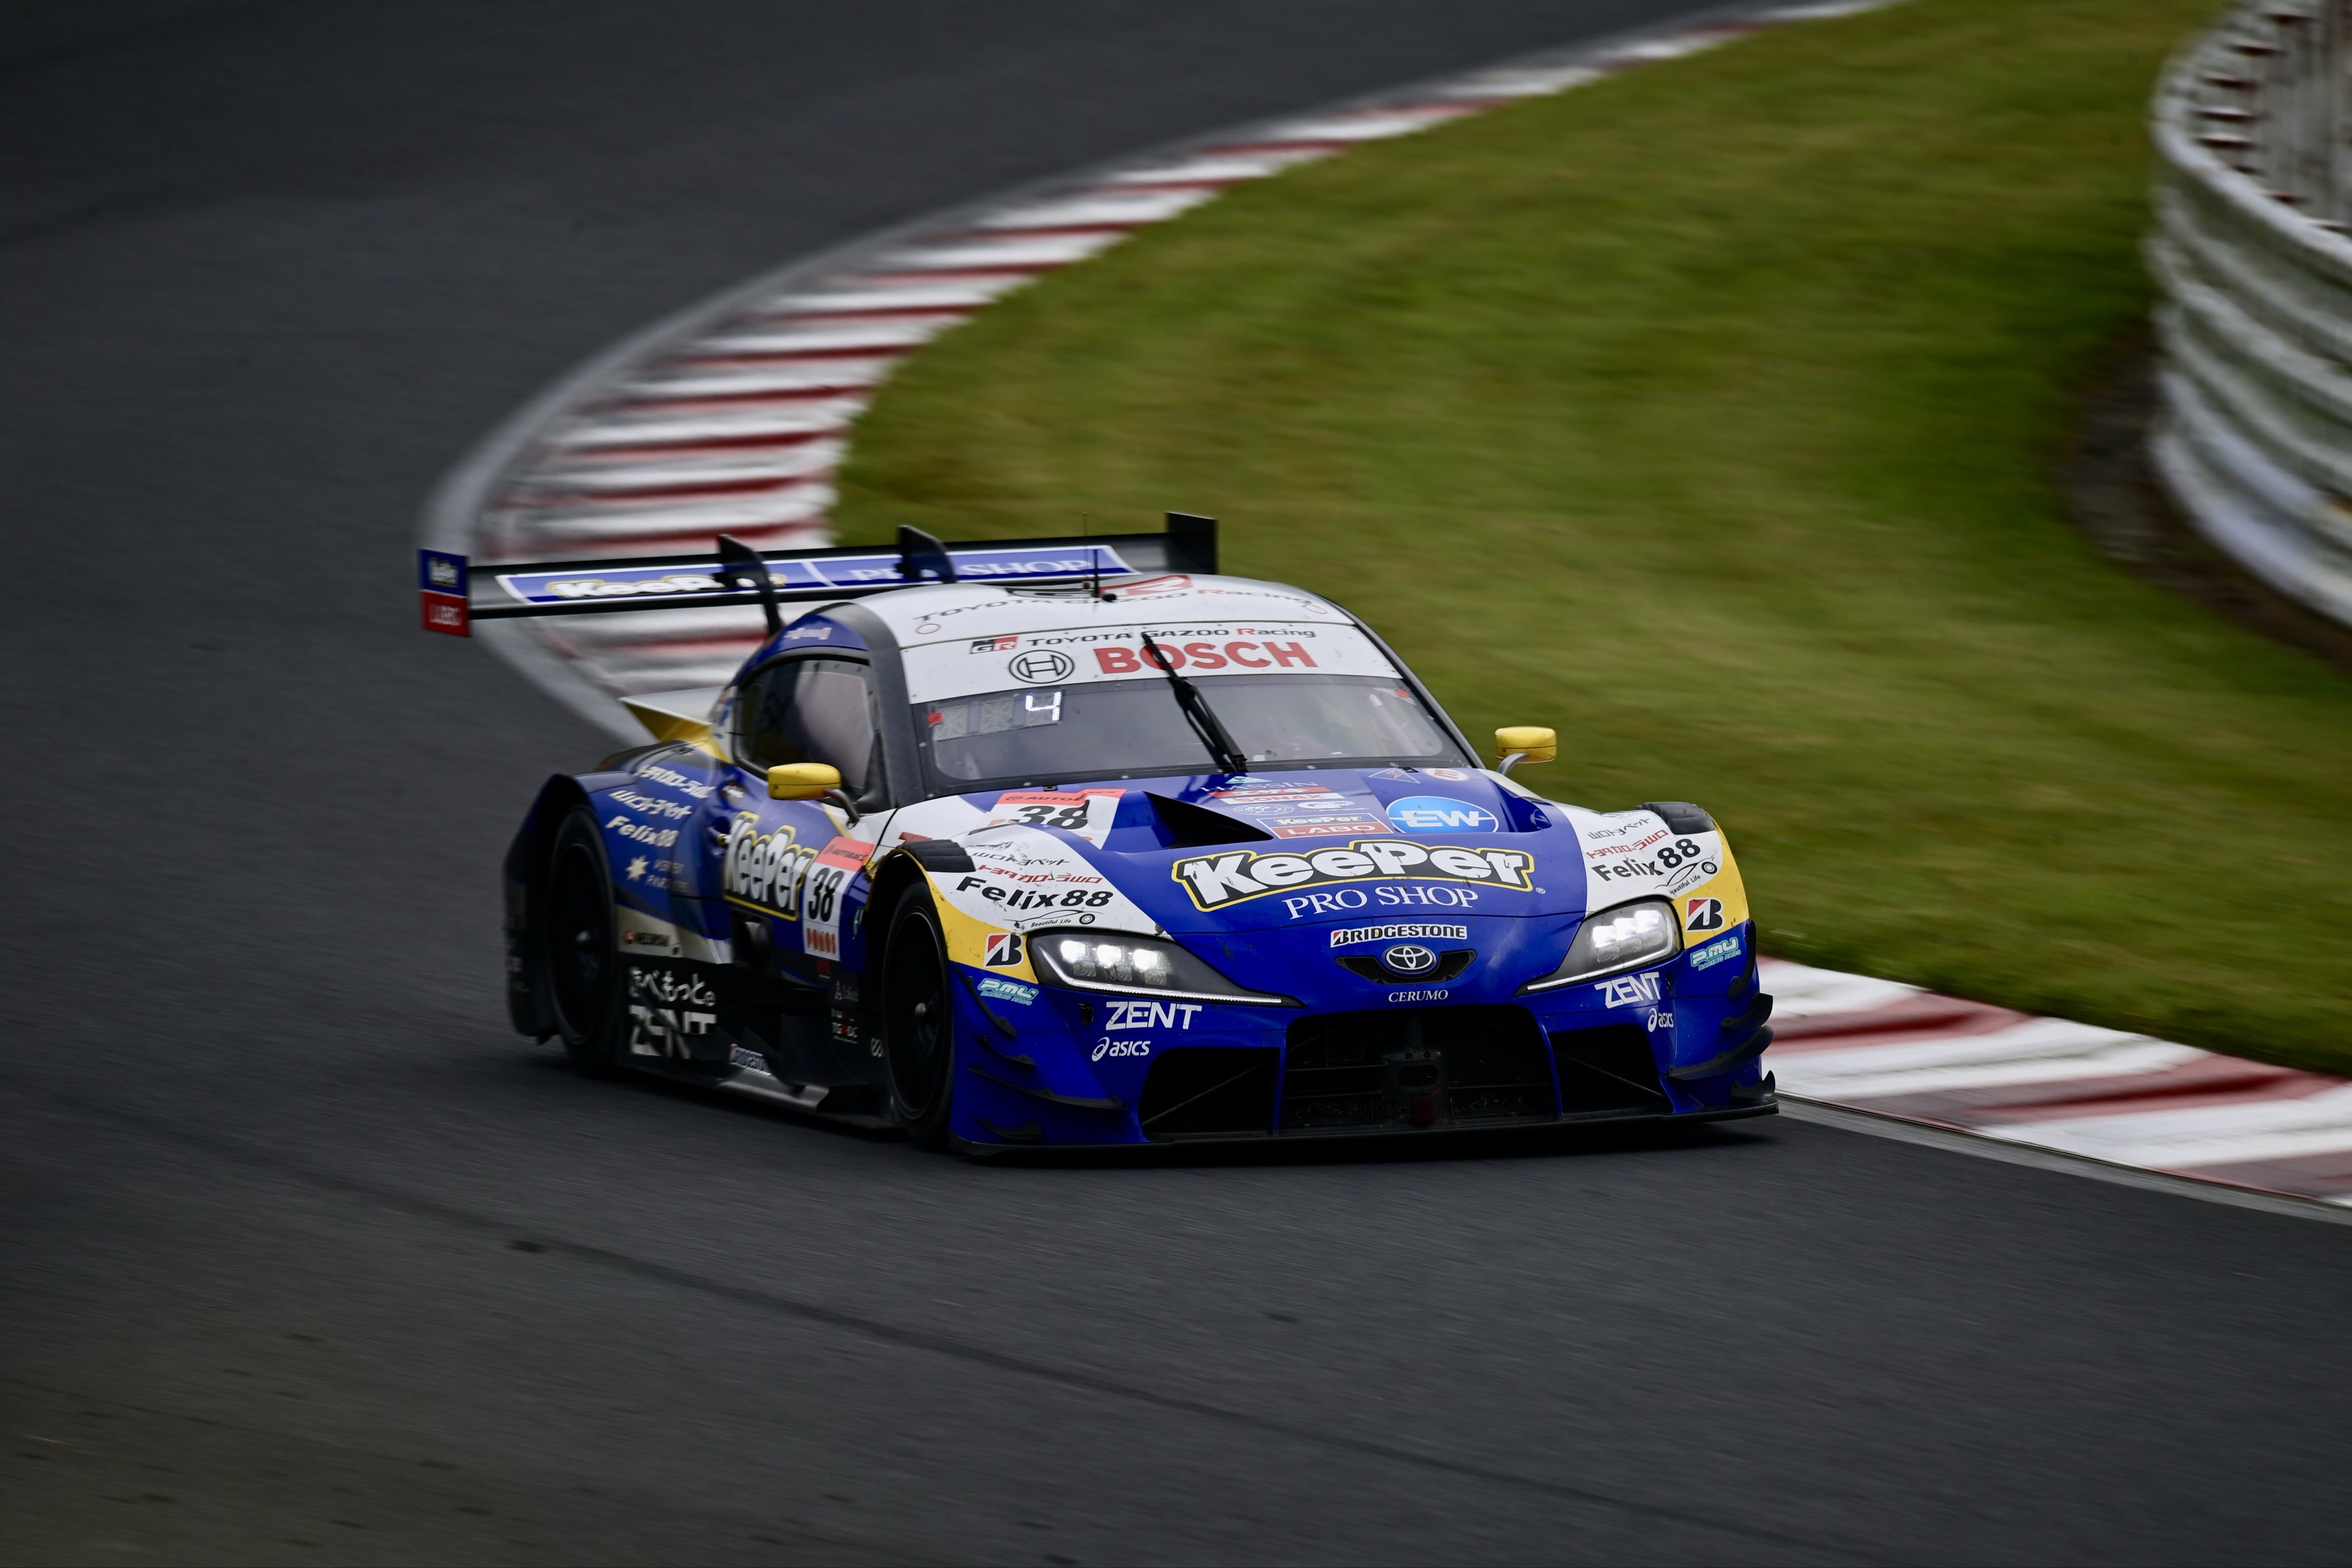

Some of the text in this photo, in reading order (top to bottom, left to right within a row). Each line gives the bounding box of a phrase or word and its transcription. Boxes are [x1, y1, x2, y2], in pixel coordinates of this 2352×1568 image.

[962, 560, 1092, 575] SHOP
[913, 598, 1053, 622] TOYOTA
[1197, 589, 1315, 606] Racing
[1025, 632, 1133, 646] TOYOTA
[1142, 628, 1229, 638] GAZOO
[1236, 628, 1316, 638] Racing
[1093, 641, 1319, 675] BOSCH
[1025, 691, 1062, 721] 4
[1235, 793, 1325, 803] SONAX
[1016, 799, 1090, 830] 38
[1275, 815, 1363, 825] KeePer
[1400, 810, 1479, 827] EW
[605, 815, 680, 847] Felix88
[1287, 824, 1375, 836] LABO
[725, 816, 815, 914] KeePer
[1180, 841, 1526, 905] KeePer
[1591, 838, 1701, 881] Felix88
[808, 867, 845, 922] 38
[956, 876, 1113, 910] Felix88
[1281, 885, 1479, 920] PRO SHOP
[1031, 919, 1058, 928] Beautiful
[1332, 925, 1467, 947] BRIDGESTONE
[1388, 989, 1449, 1003] CERUMO
[1594, 971, 1661, 1009] ZENT
[1105, 1001, 1202, 1031] ZENT
